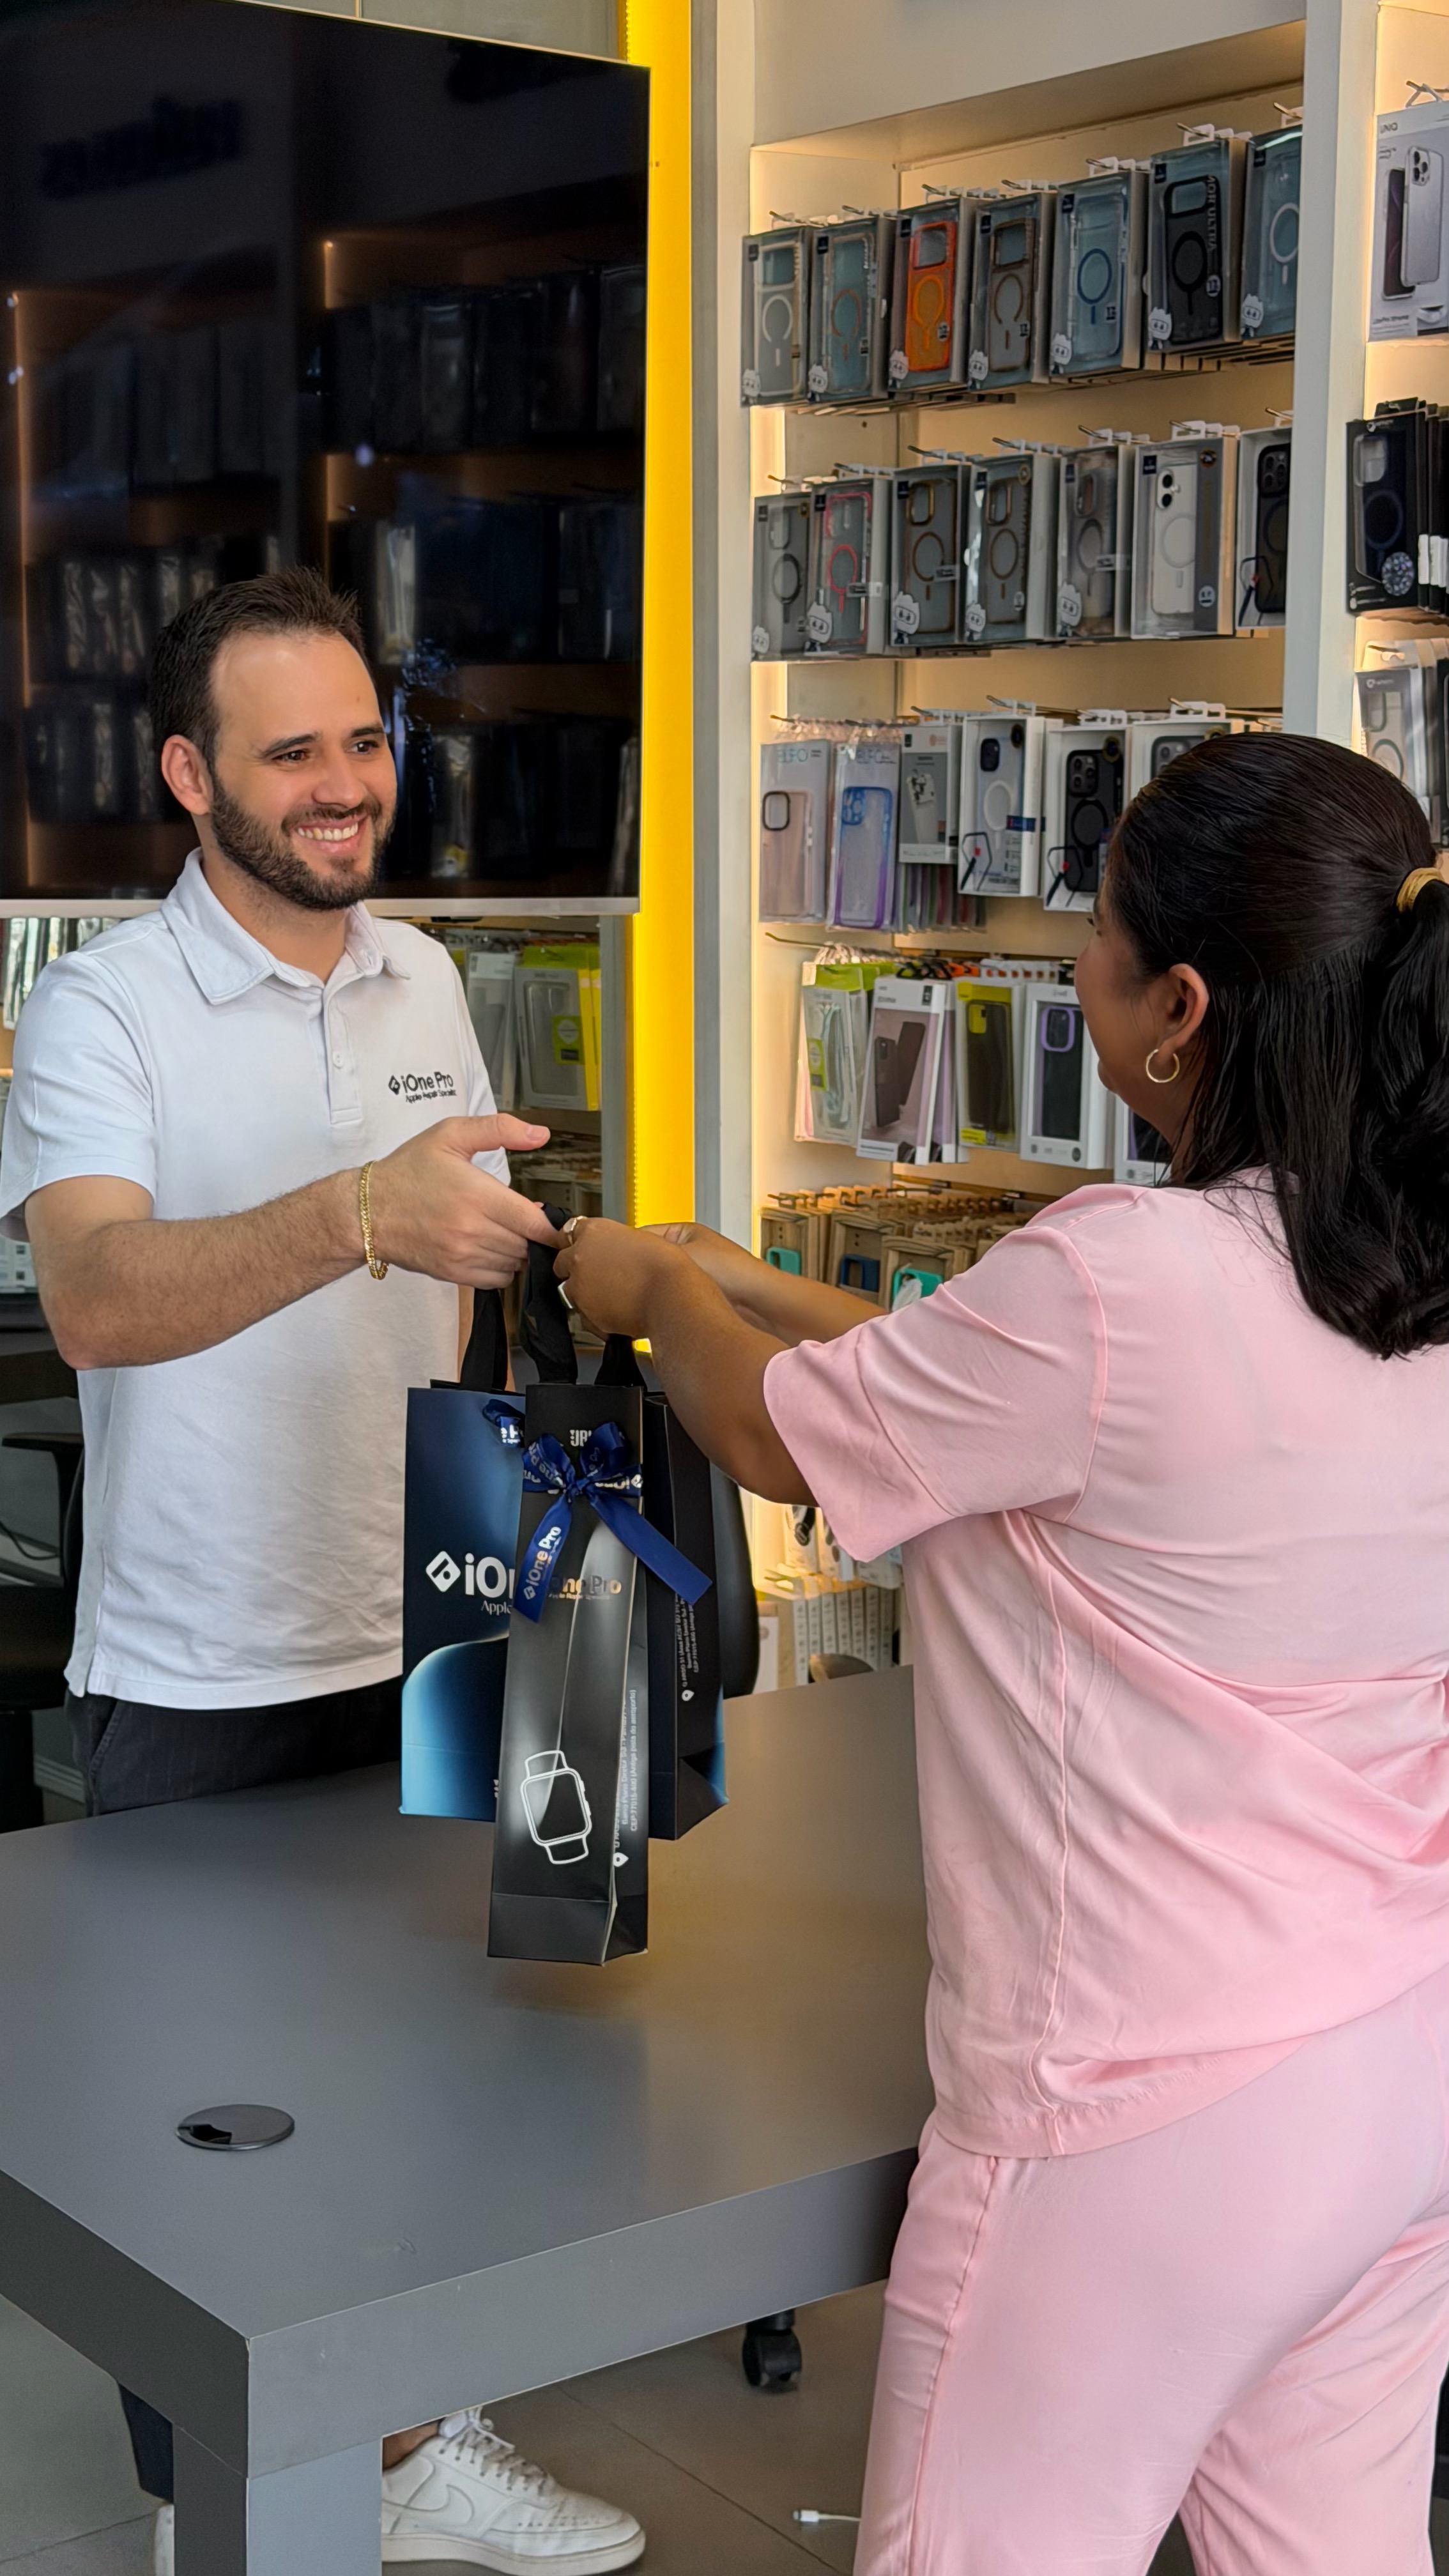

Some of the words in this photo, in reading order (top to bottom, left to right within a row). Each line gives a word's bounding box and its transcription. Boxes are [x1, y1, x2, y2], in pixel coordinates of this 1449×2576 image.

[401, 1073, 434, 1093] iOne
[434, 1071, 454, 1089] Pro
[406, 1094, 422, 1104] Apple
[525, 1549, 549, 1587] iOne
[538, 1526, 562, 1549] Pro
[464, 1552, 516, 1599] iO
[590, 1574, 622, 1595] Pro
[629, 1689, 637, 1725] aeroporto)
[630, 1726, 636, 1735] do
